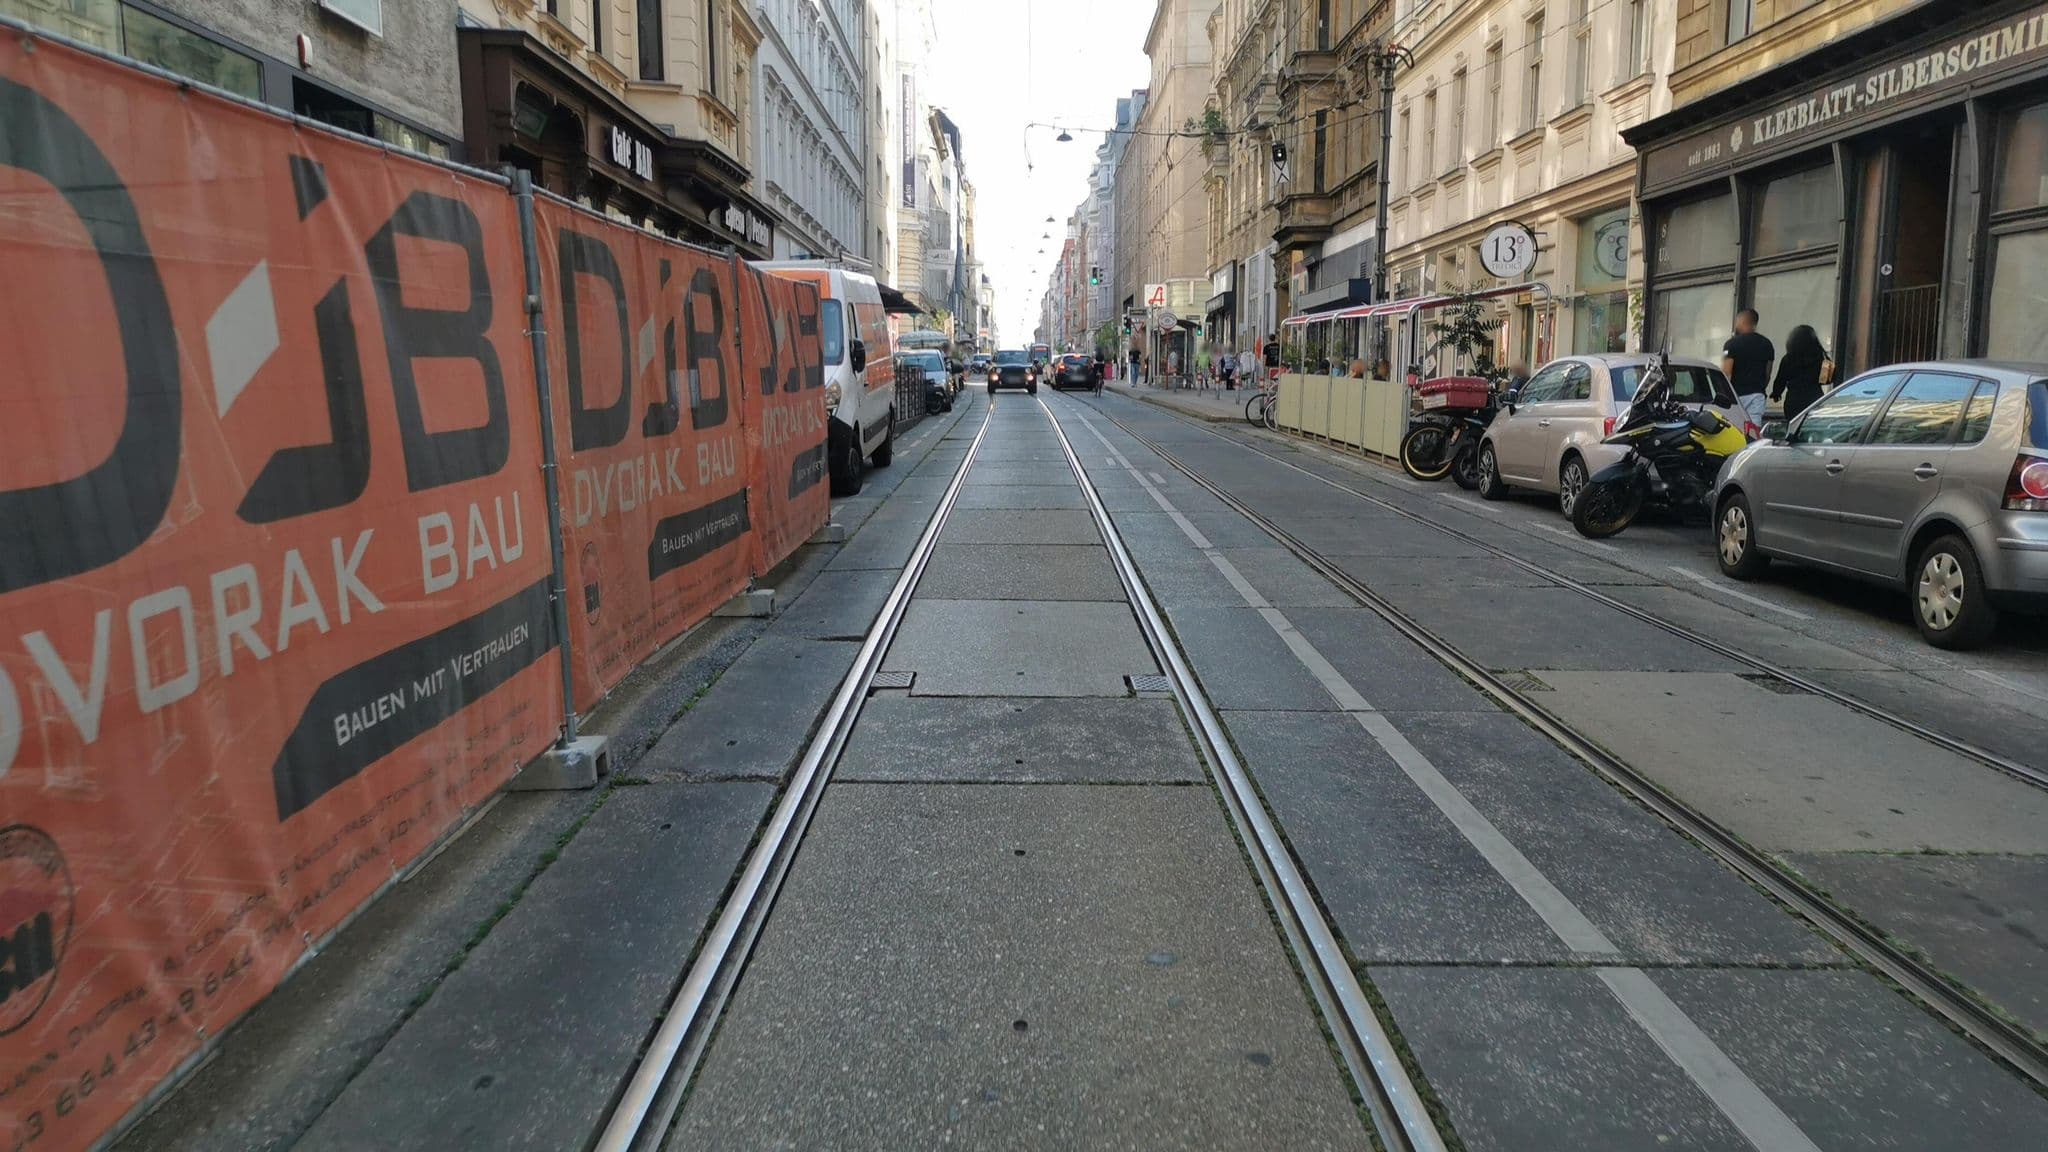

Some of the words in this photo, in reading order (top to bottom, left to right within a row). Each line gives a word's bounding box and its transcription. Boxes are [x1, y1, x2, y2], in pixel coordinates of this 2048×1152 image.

[635, 139, 653, 182] BAR
[698, 436, 735, 486] BAU
[0, 528, 386, 786] VORAK
[418, 491, 524, 595] BAU
[333, 688, 405, 746] BAUEN
[413, 668, 446, 702] MIT
[450, 621, 530, 680] VERTRAUEN
